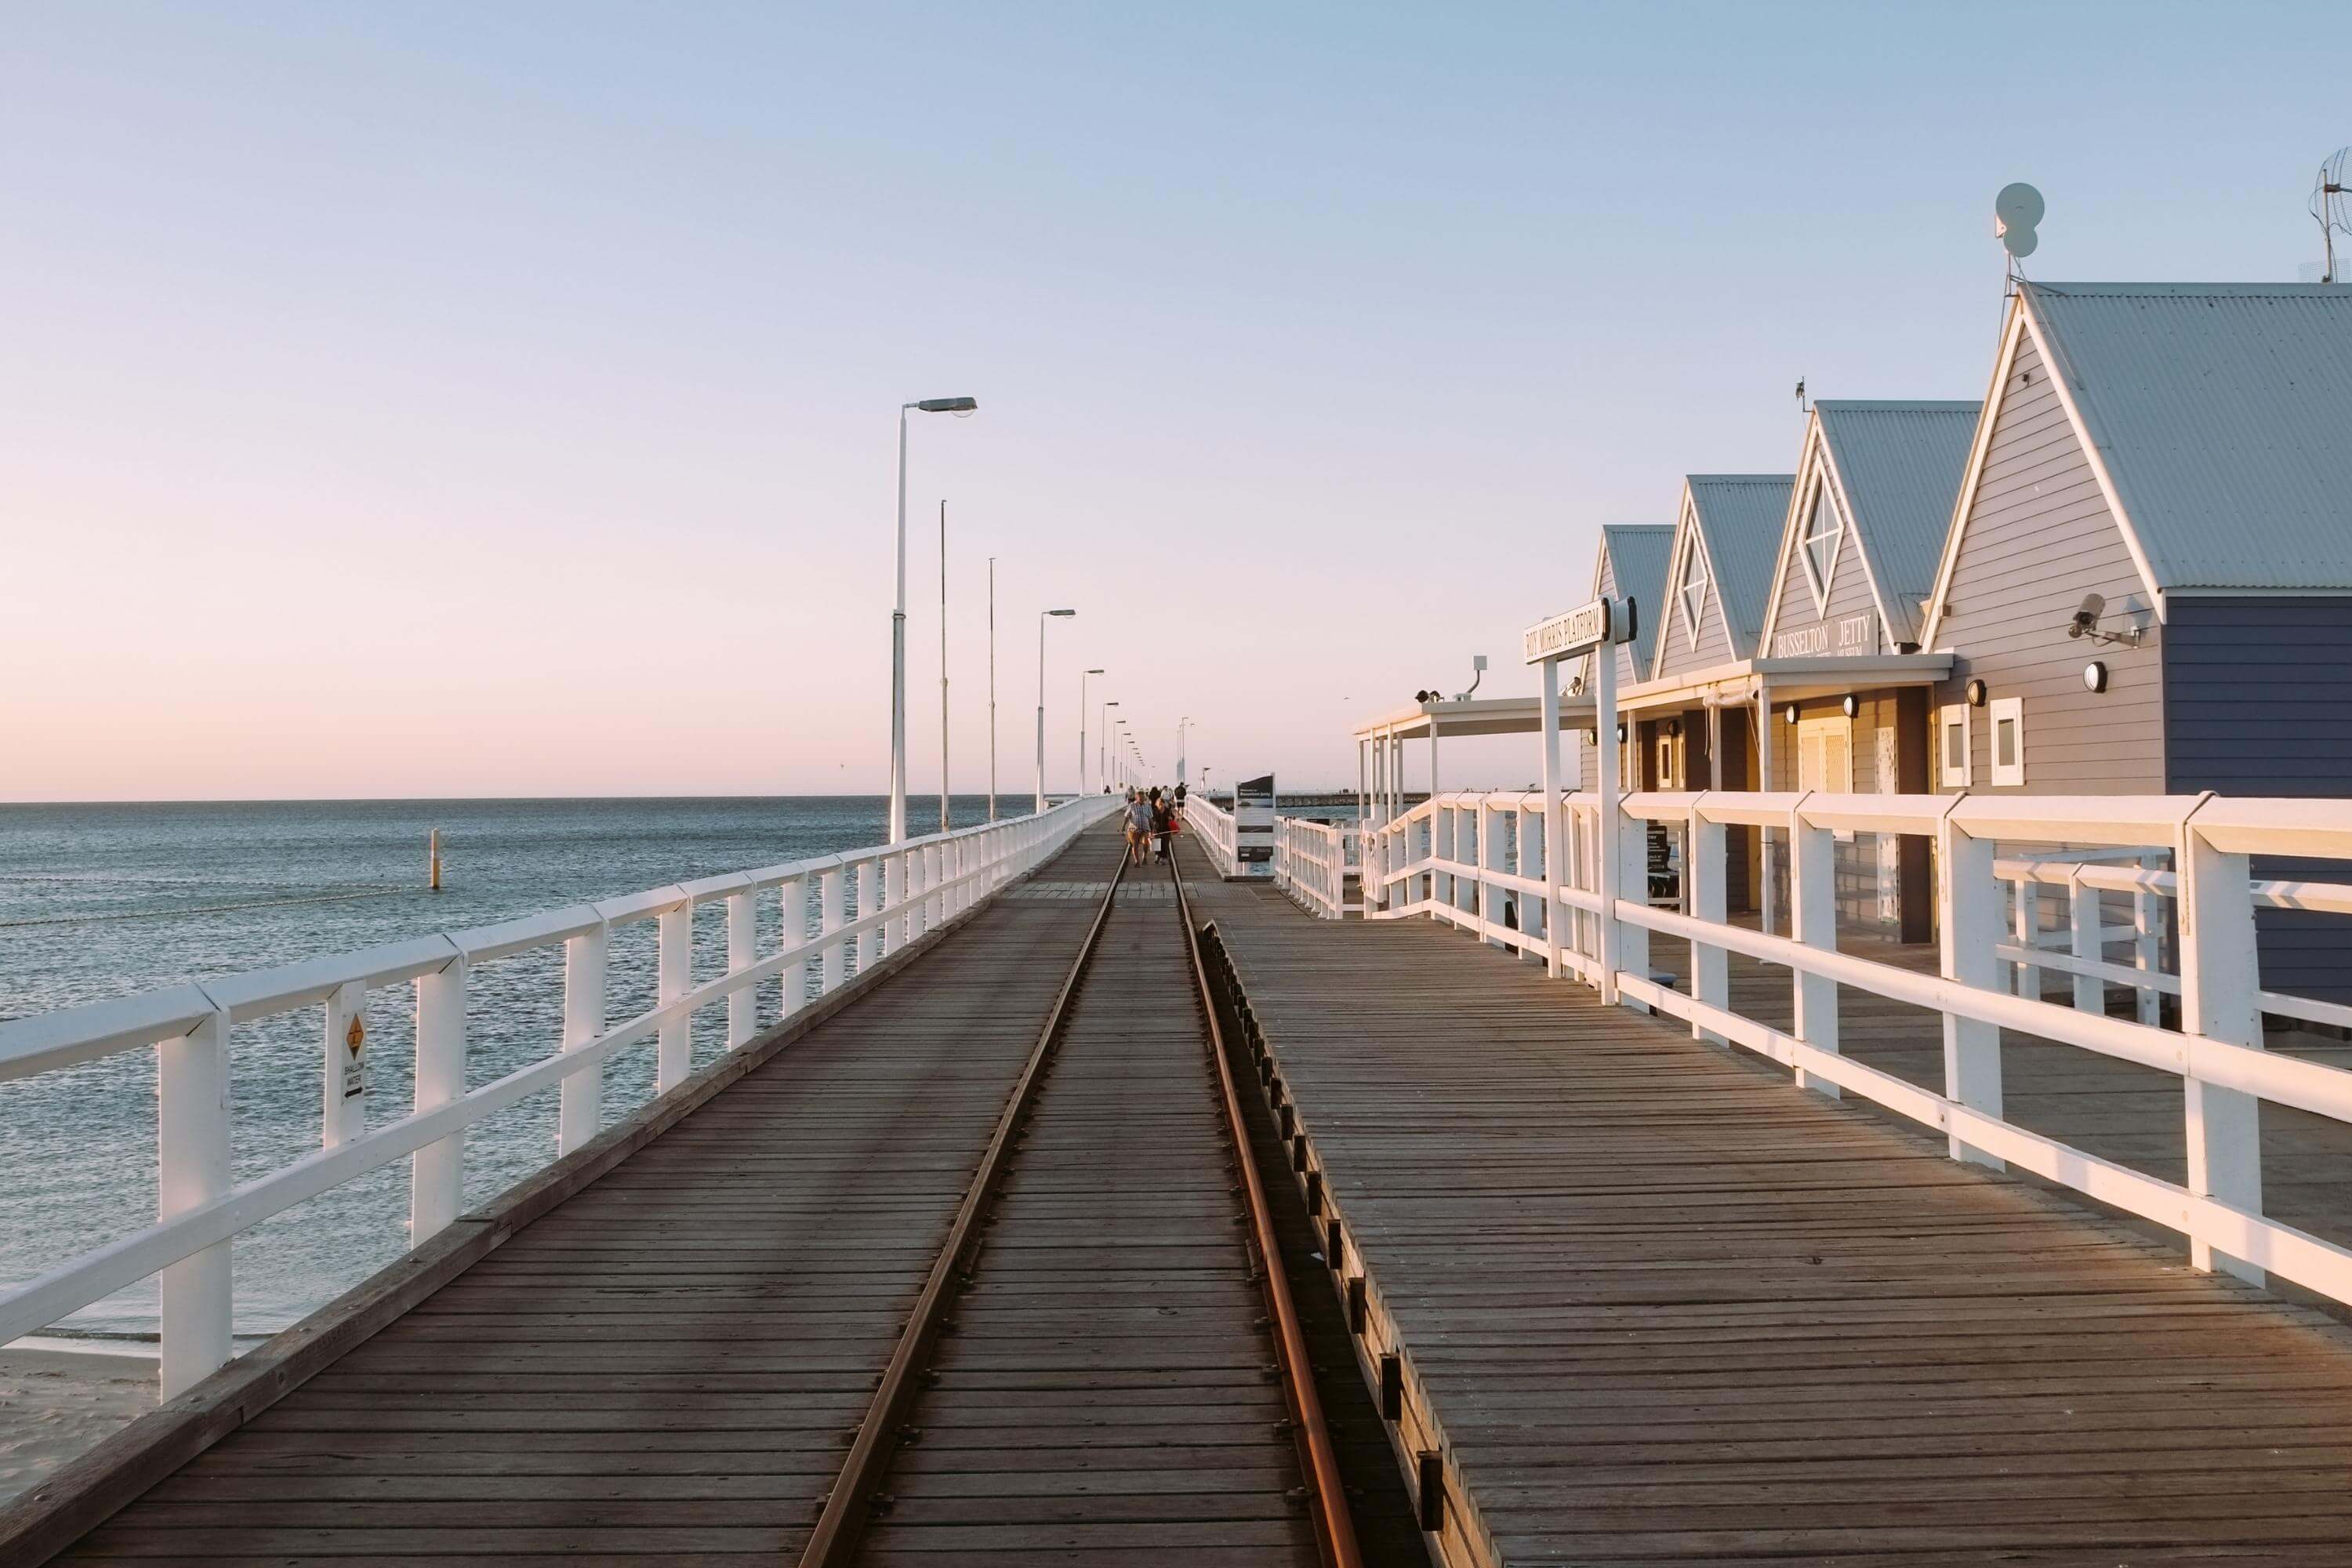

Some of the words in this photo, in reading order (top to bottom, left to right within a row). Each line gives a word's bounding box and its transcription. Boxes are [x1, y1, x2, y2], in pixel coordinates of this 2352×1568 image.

[1539, 622, 1563, 652] MORRIS
[1564, 608, 1599, 645] PLATFORM
[1777, 626, 1828, 659] BUSSELTON
[1838, 615, 1871, 647] JETTY
[347, 1075, 361, 1087] WATER
